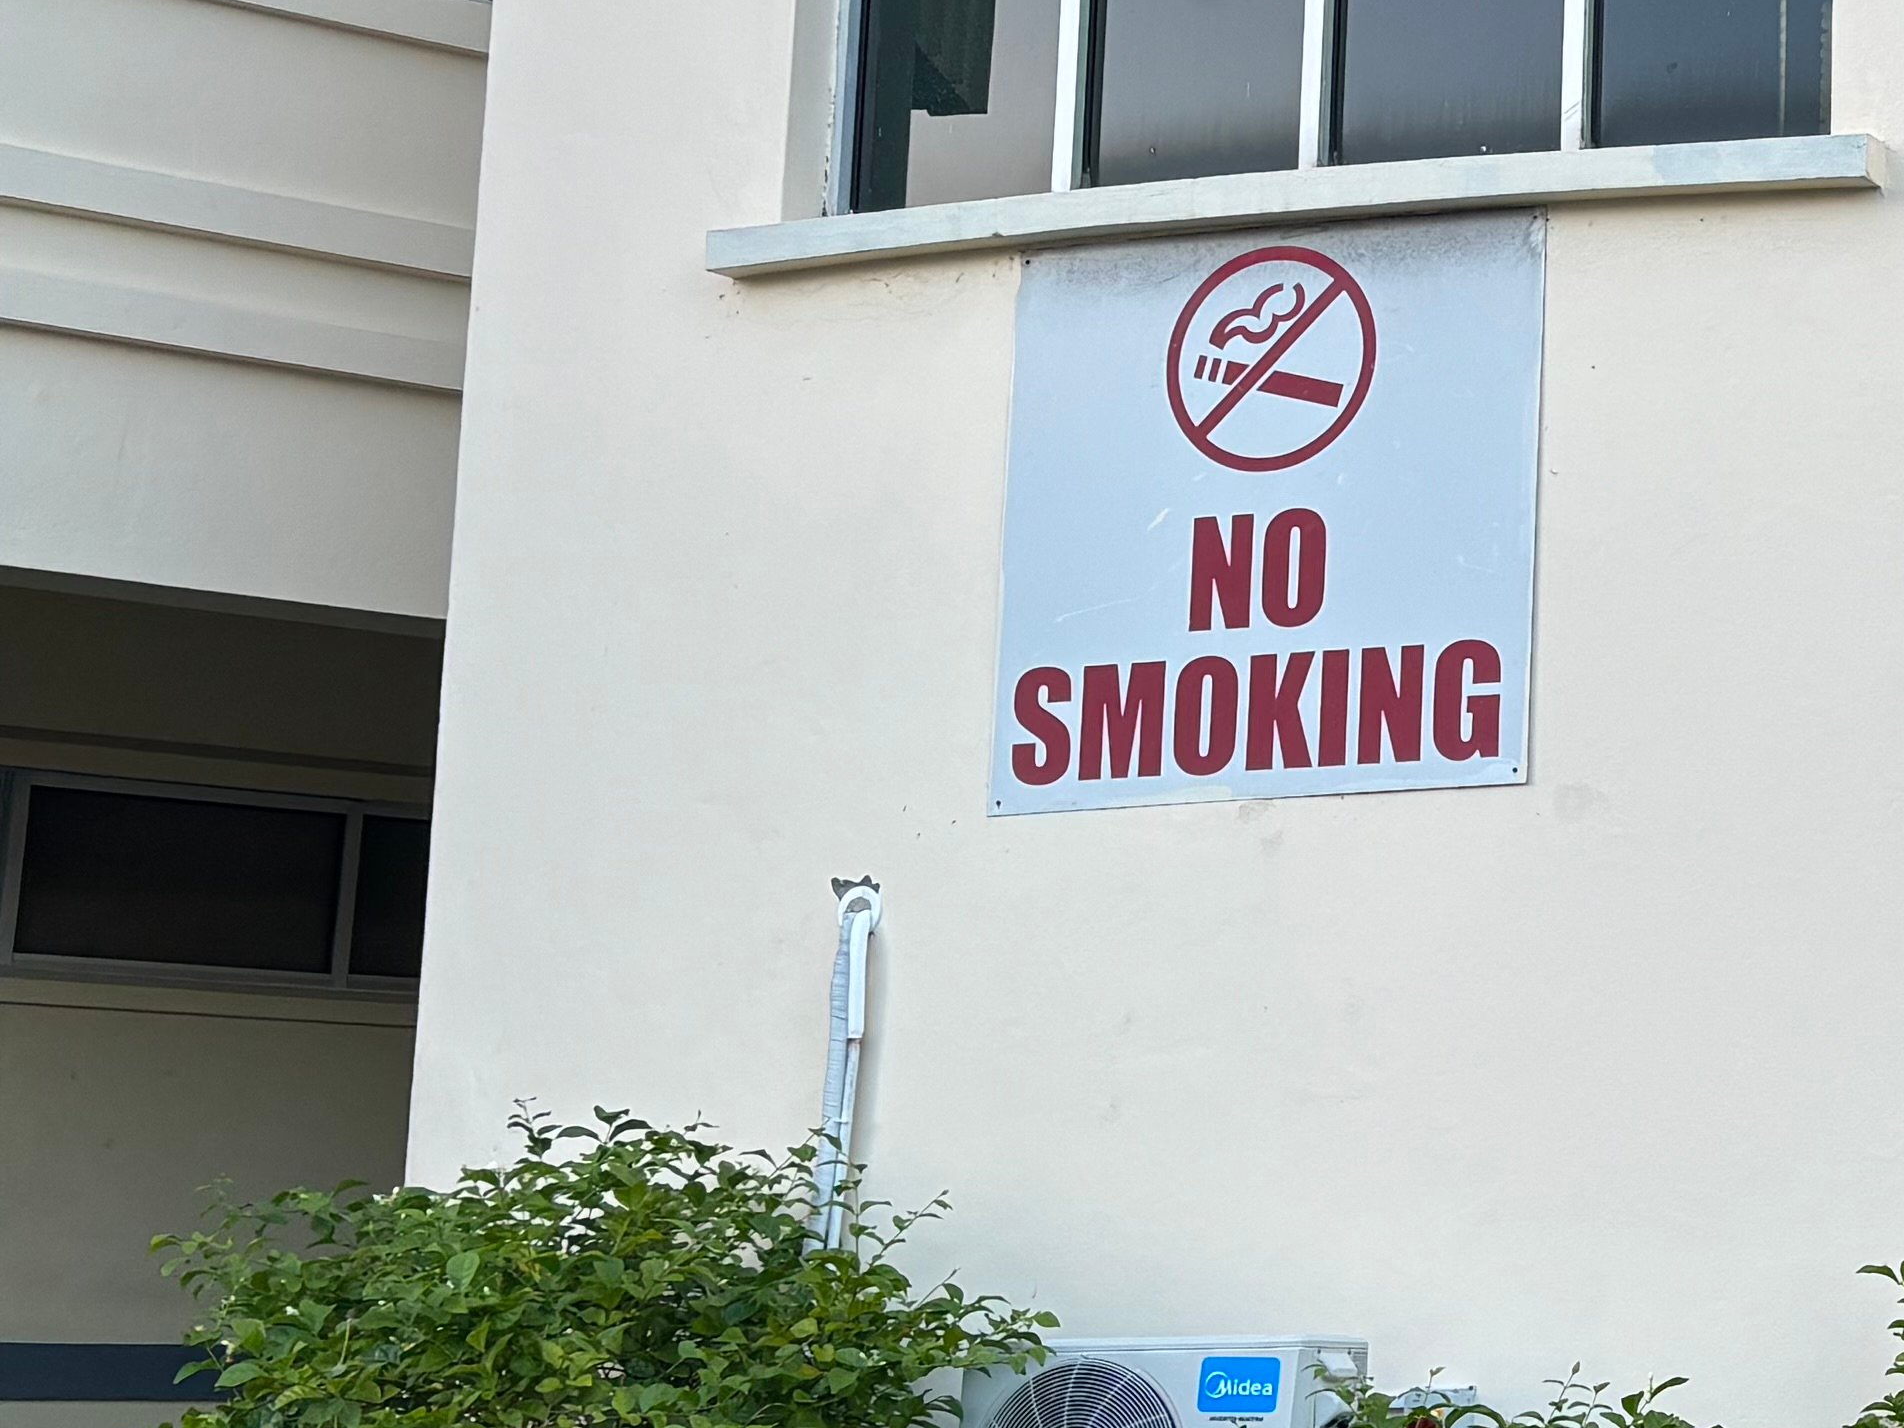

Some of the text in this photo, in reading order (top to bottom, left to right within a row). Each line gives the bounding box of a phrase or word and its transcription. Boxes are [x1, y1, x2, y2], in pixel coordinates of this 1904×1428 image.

[1188, 507, 1327, 633] NO
[1011, 639, 1502, 786] SMOKING
[1204, 1371, 1274, 1399] Midea
